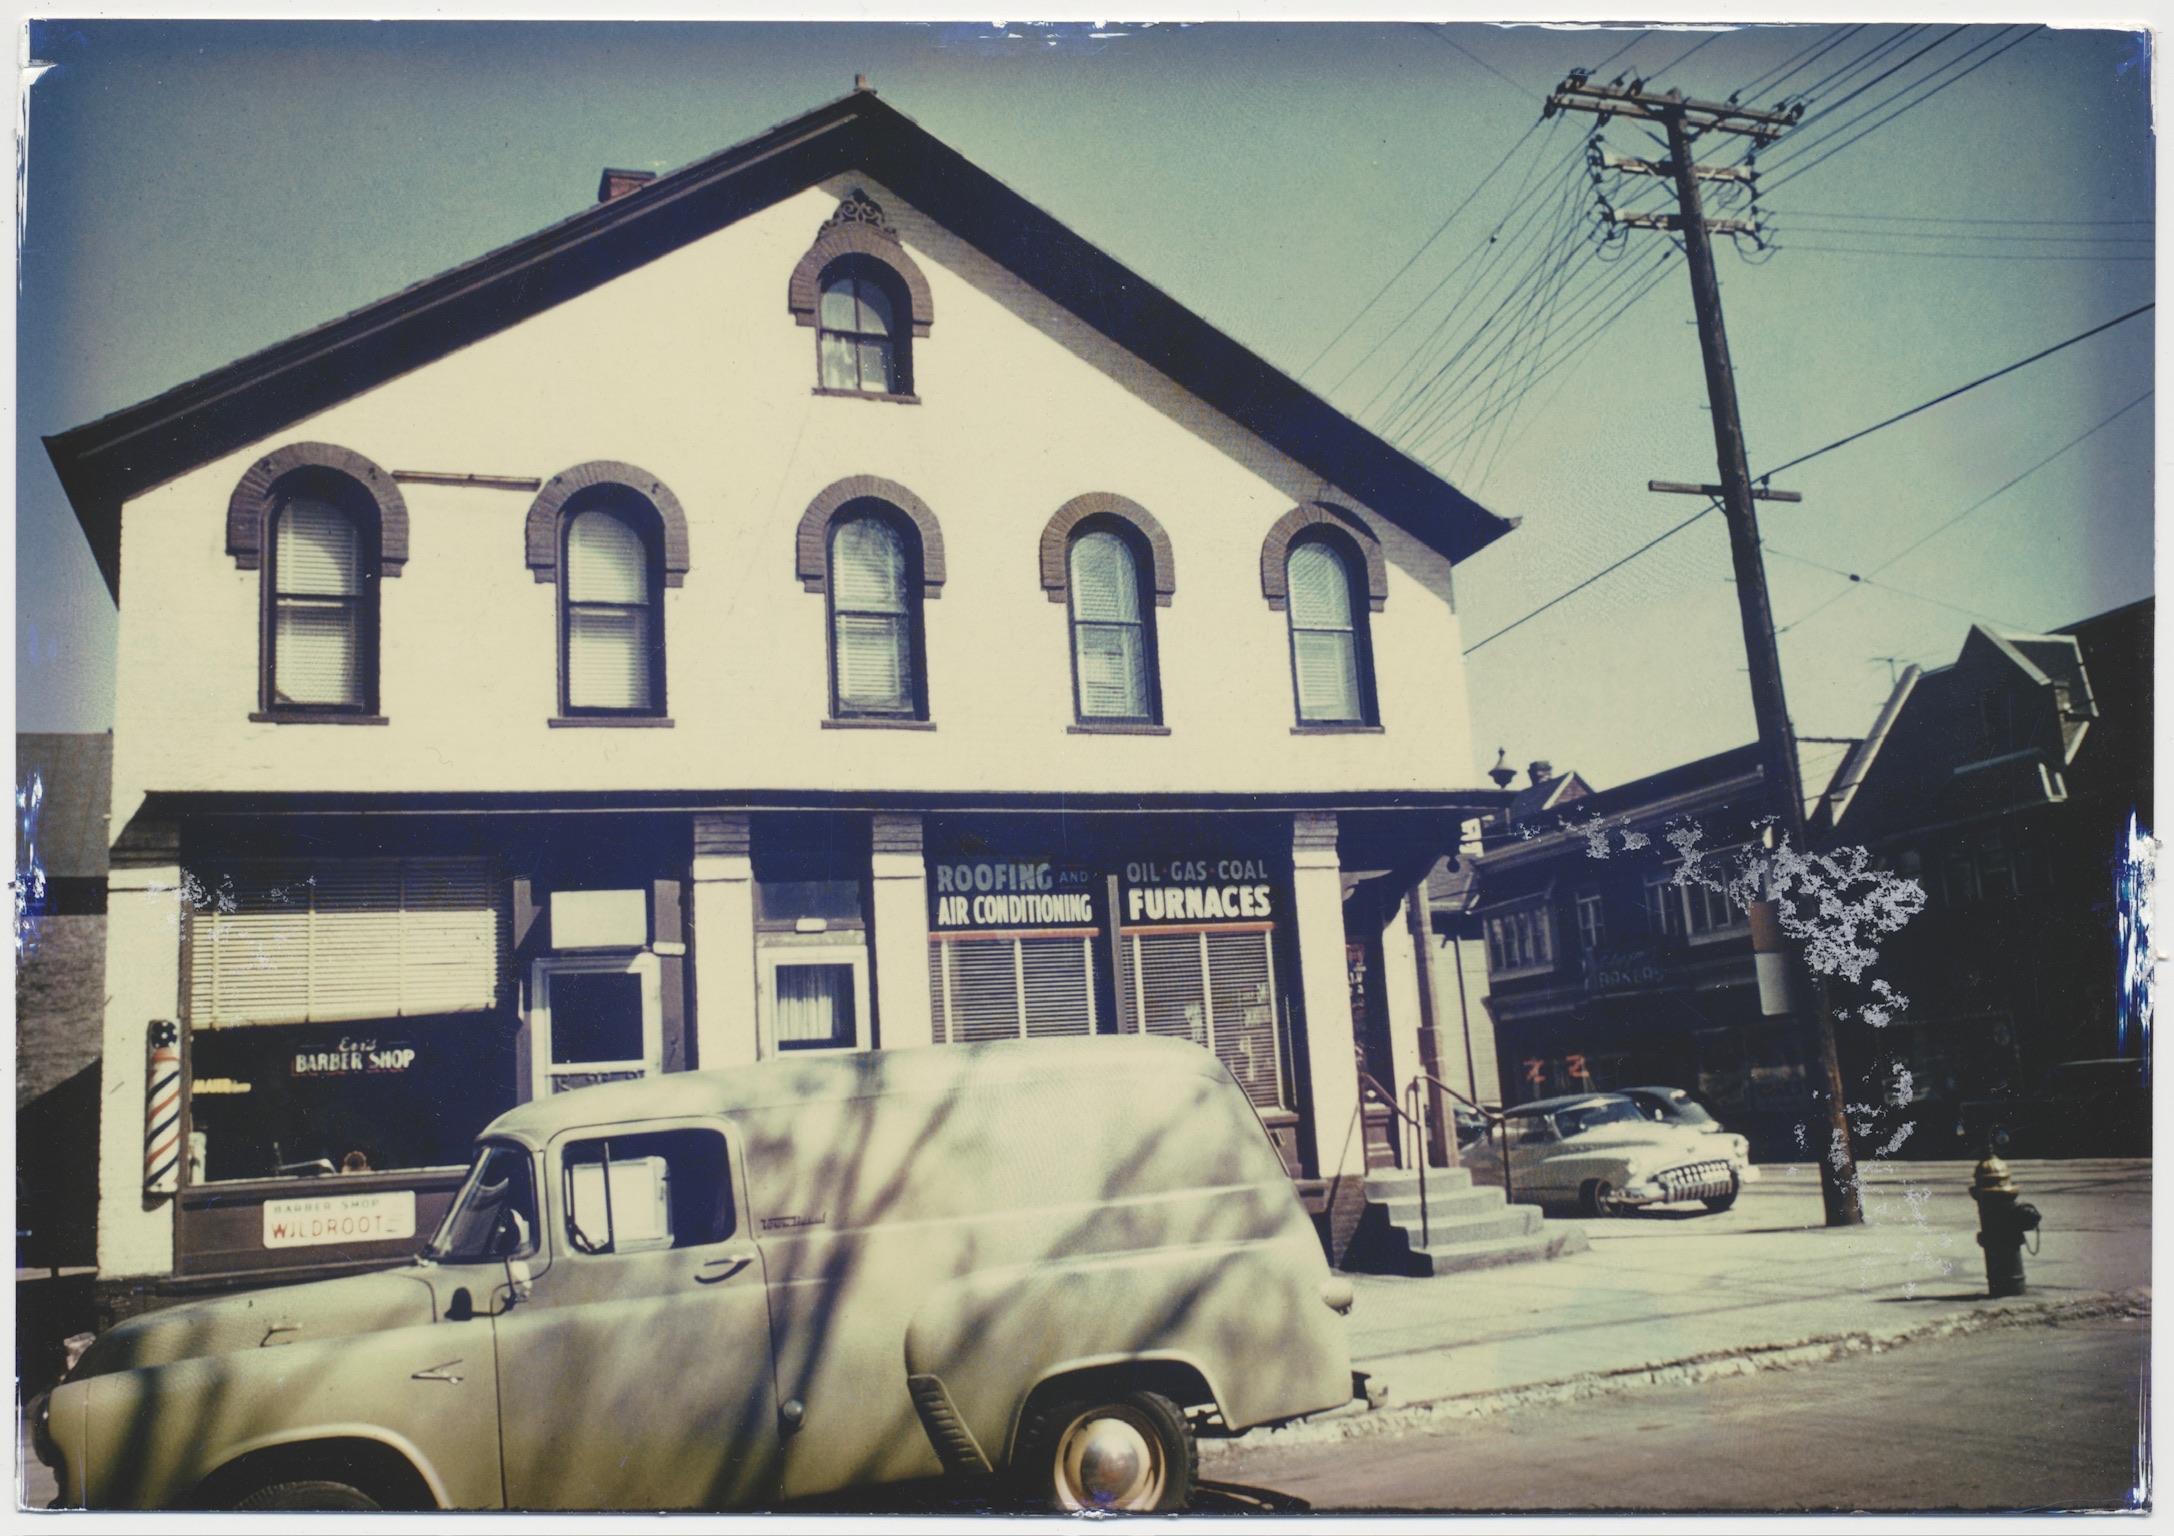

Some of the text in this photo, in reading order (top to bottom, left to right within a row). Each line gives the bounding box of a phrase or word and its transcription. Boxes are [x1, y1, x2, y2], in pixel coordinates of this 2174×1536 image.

[936, 862, 1089, 892] ROOFING AND
[1126, 859, 1268, 883] OIL GAS COAL
[937, 893, 1093, 926] AIR CONDITIONING
[1128, 884, 1272, 921] FURNACES
[294, 1048, 416, 1074] BARBER SHOP
[274, 1198, 380, 1214] BARBER SHOP
[271, 1215, 382, 1239] WILDROOT
